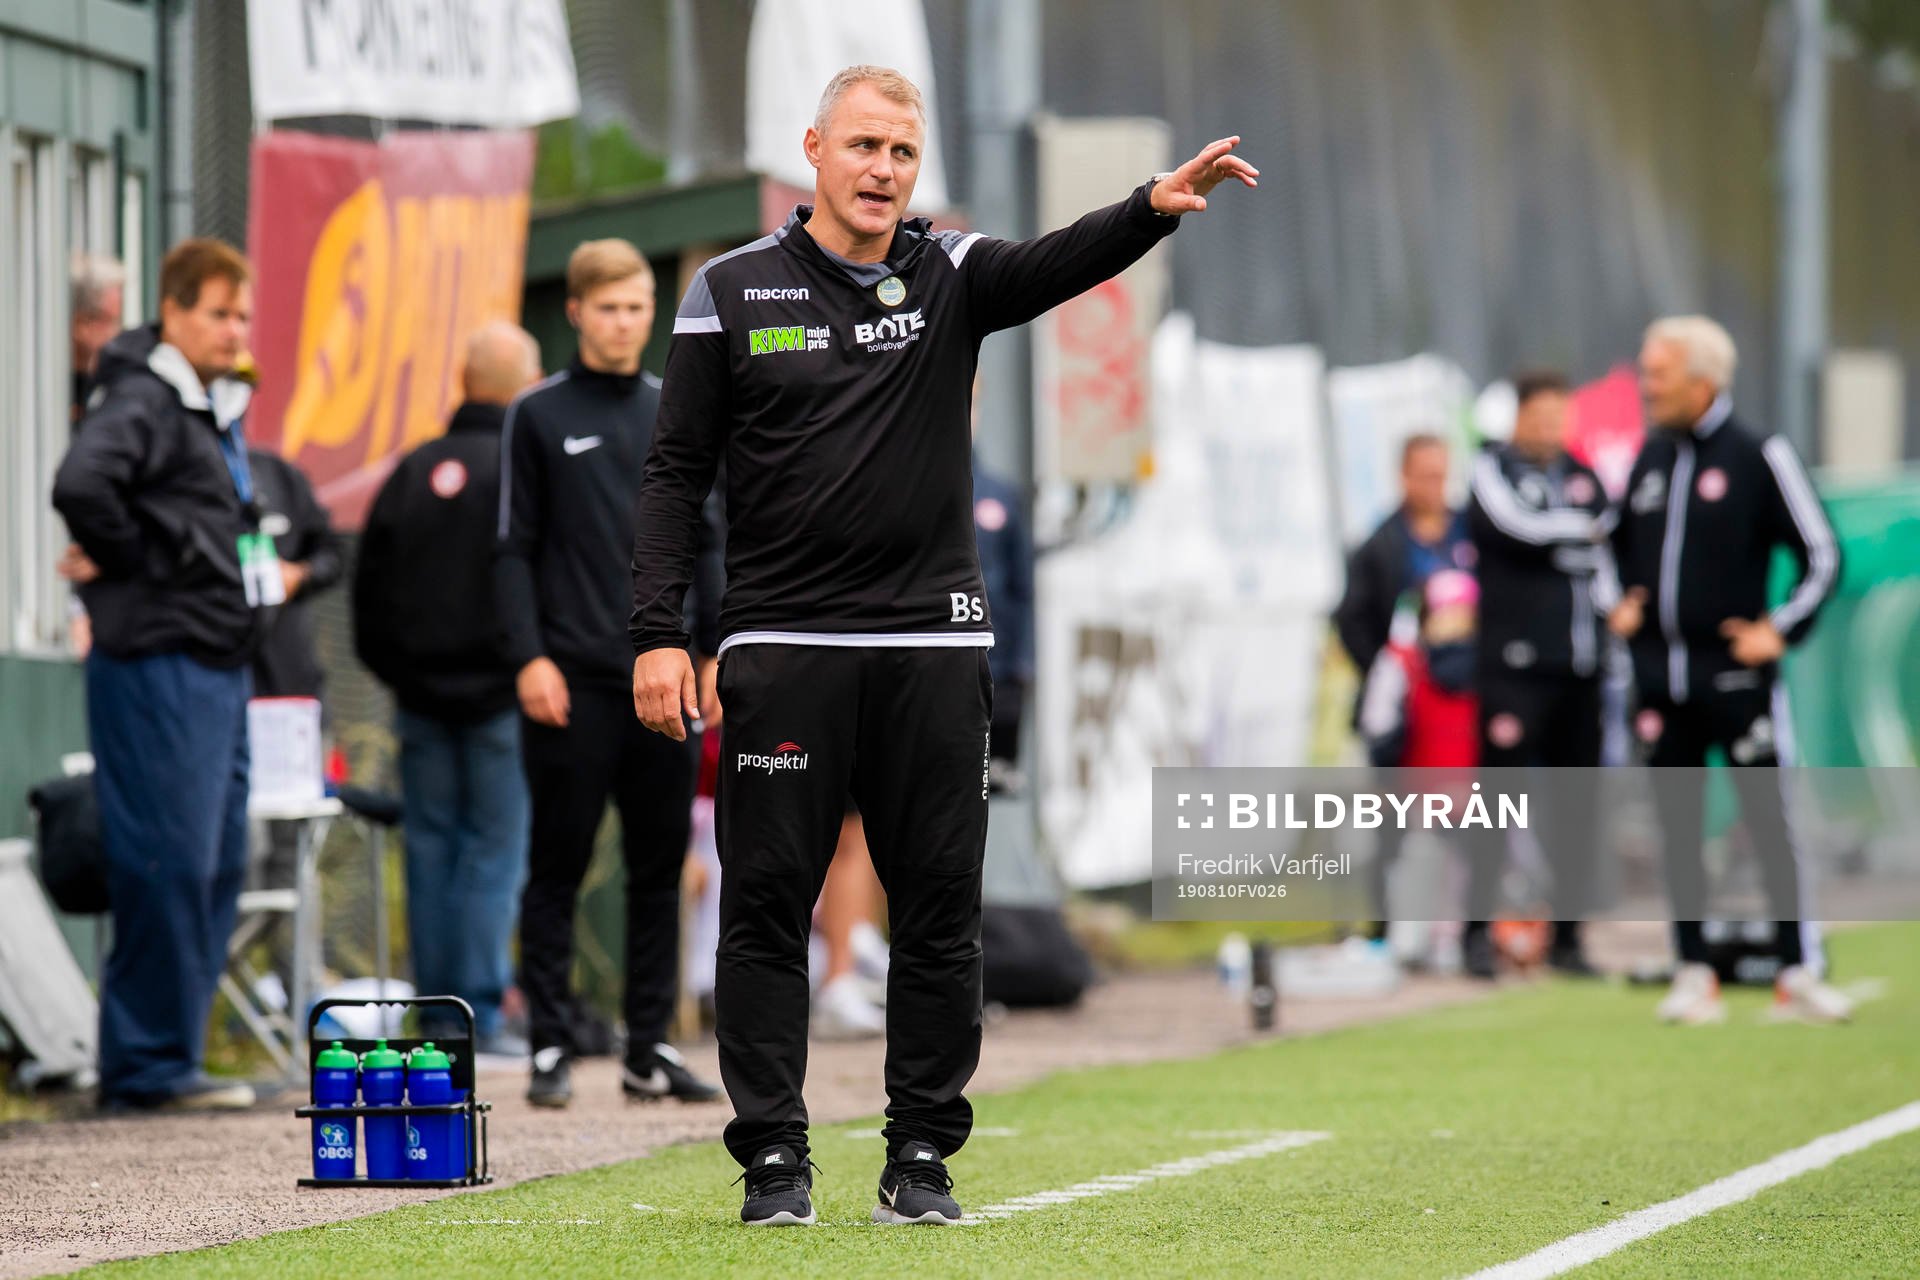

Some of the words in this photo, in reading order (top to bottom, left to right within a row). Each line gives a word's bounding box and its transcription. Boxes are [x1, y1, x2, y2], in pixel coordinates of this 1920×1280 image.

[744, 288, 809, 300] macron
[806, 325, 831, 338] mini
[750, 325, 806, 356] KIWI
[807, 337, 829, 351] pris
[950, 592, 984, 622] Bs
[737, 753, 808, 775] prosjektil
[318, 1147, 353, 1159] OBOS
[408, 1148, 427, 1160] OS
